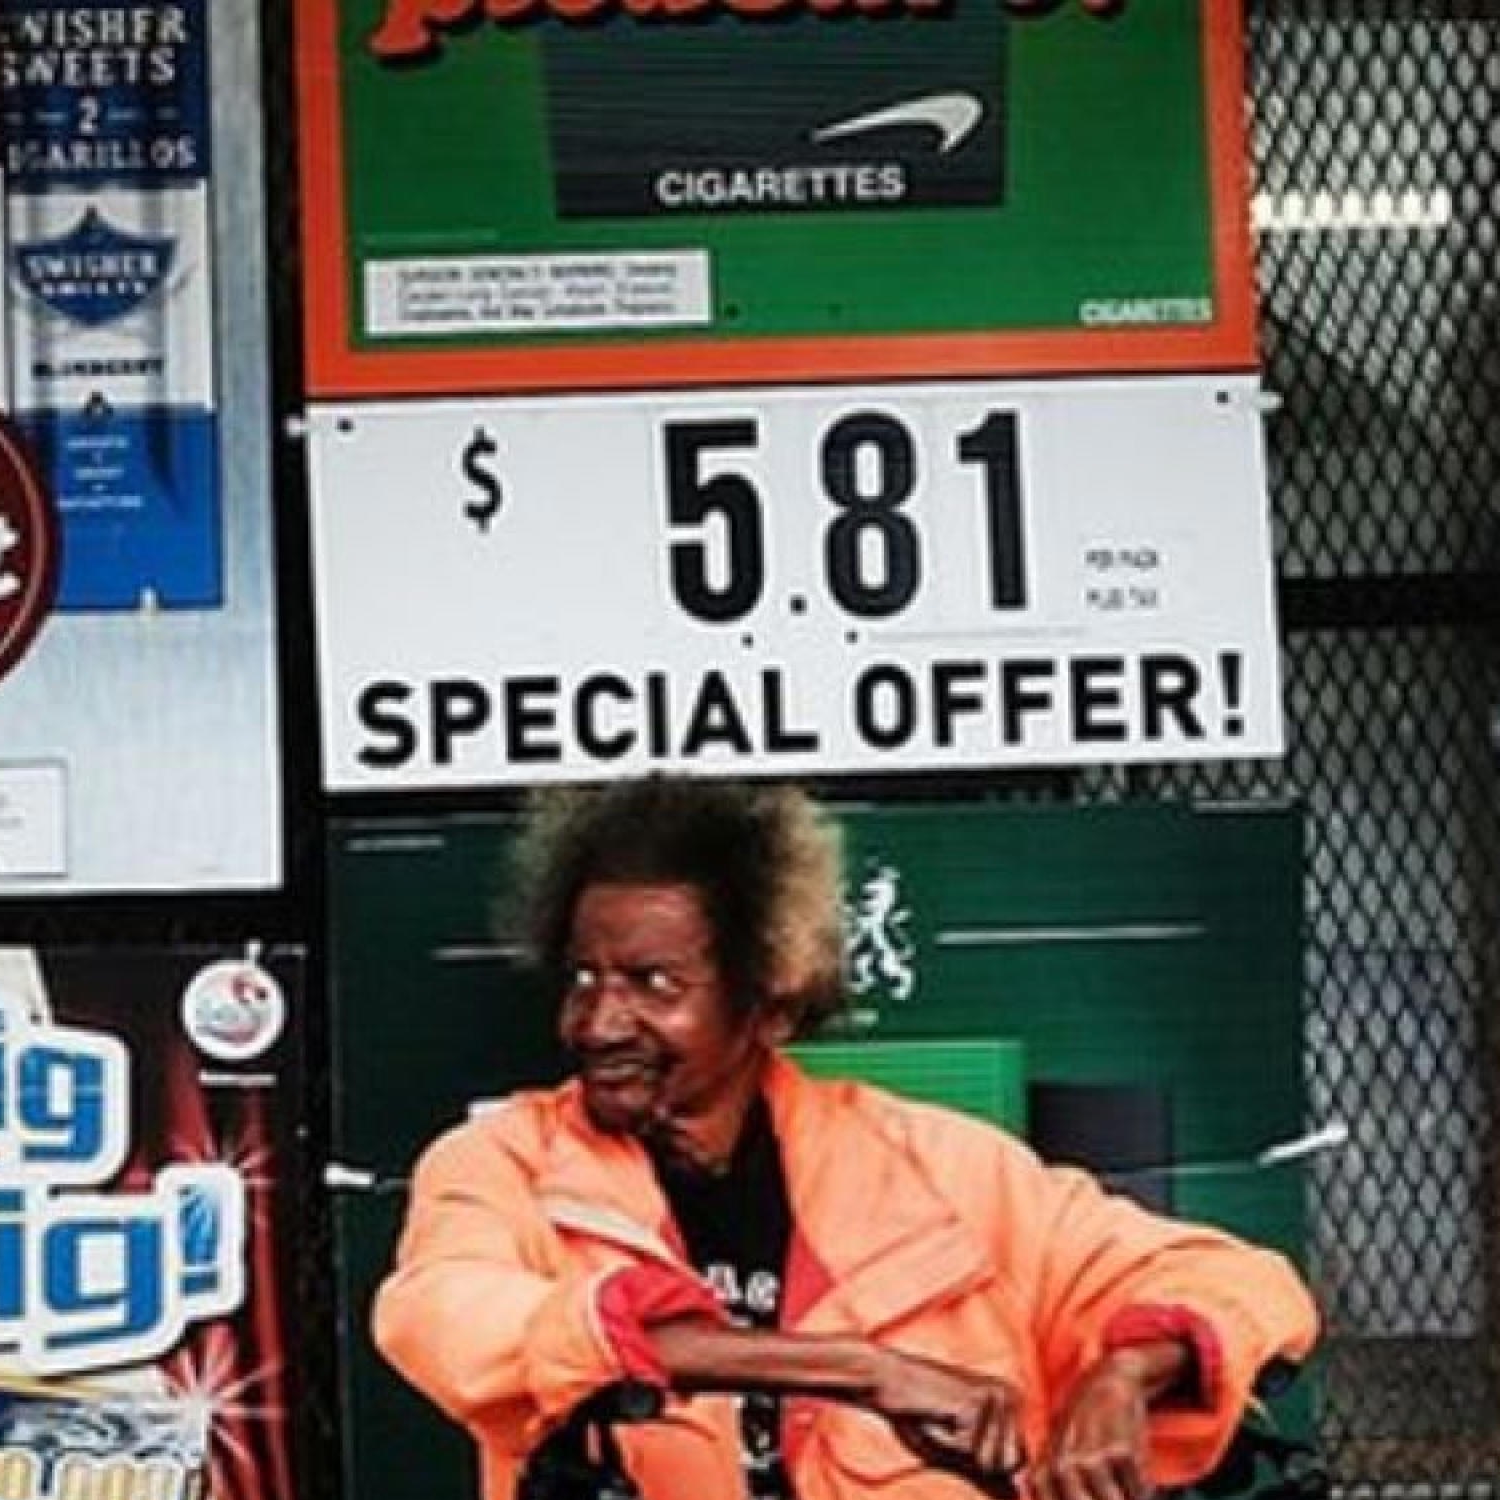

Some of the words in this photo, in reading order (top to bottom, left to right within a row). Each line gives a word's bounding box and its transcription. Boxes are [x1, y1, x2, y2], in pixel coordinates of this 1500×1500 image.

[78, 95, 99, 134] 2
[655, 167, 906, 205] CIGARETTES
[663, 411, 1029, 624] 5.81
[357, 669, 820, 770] SPECIAL
[855, 652, 1242, 749] OFFER!
